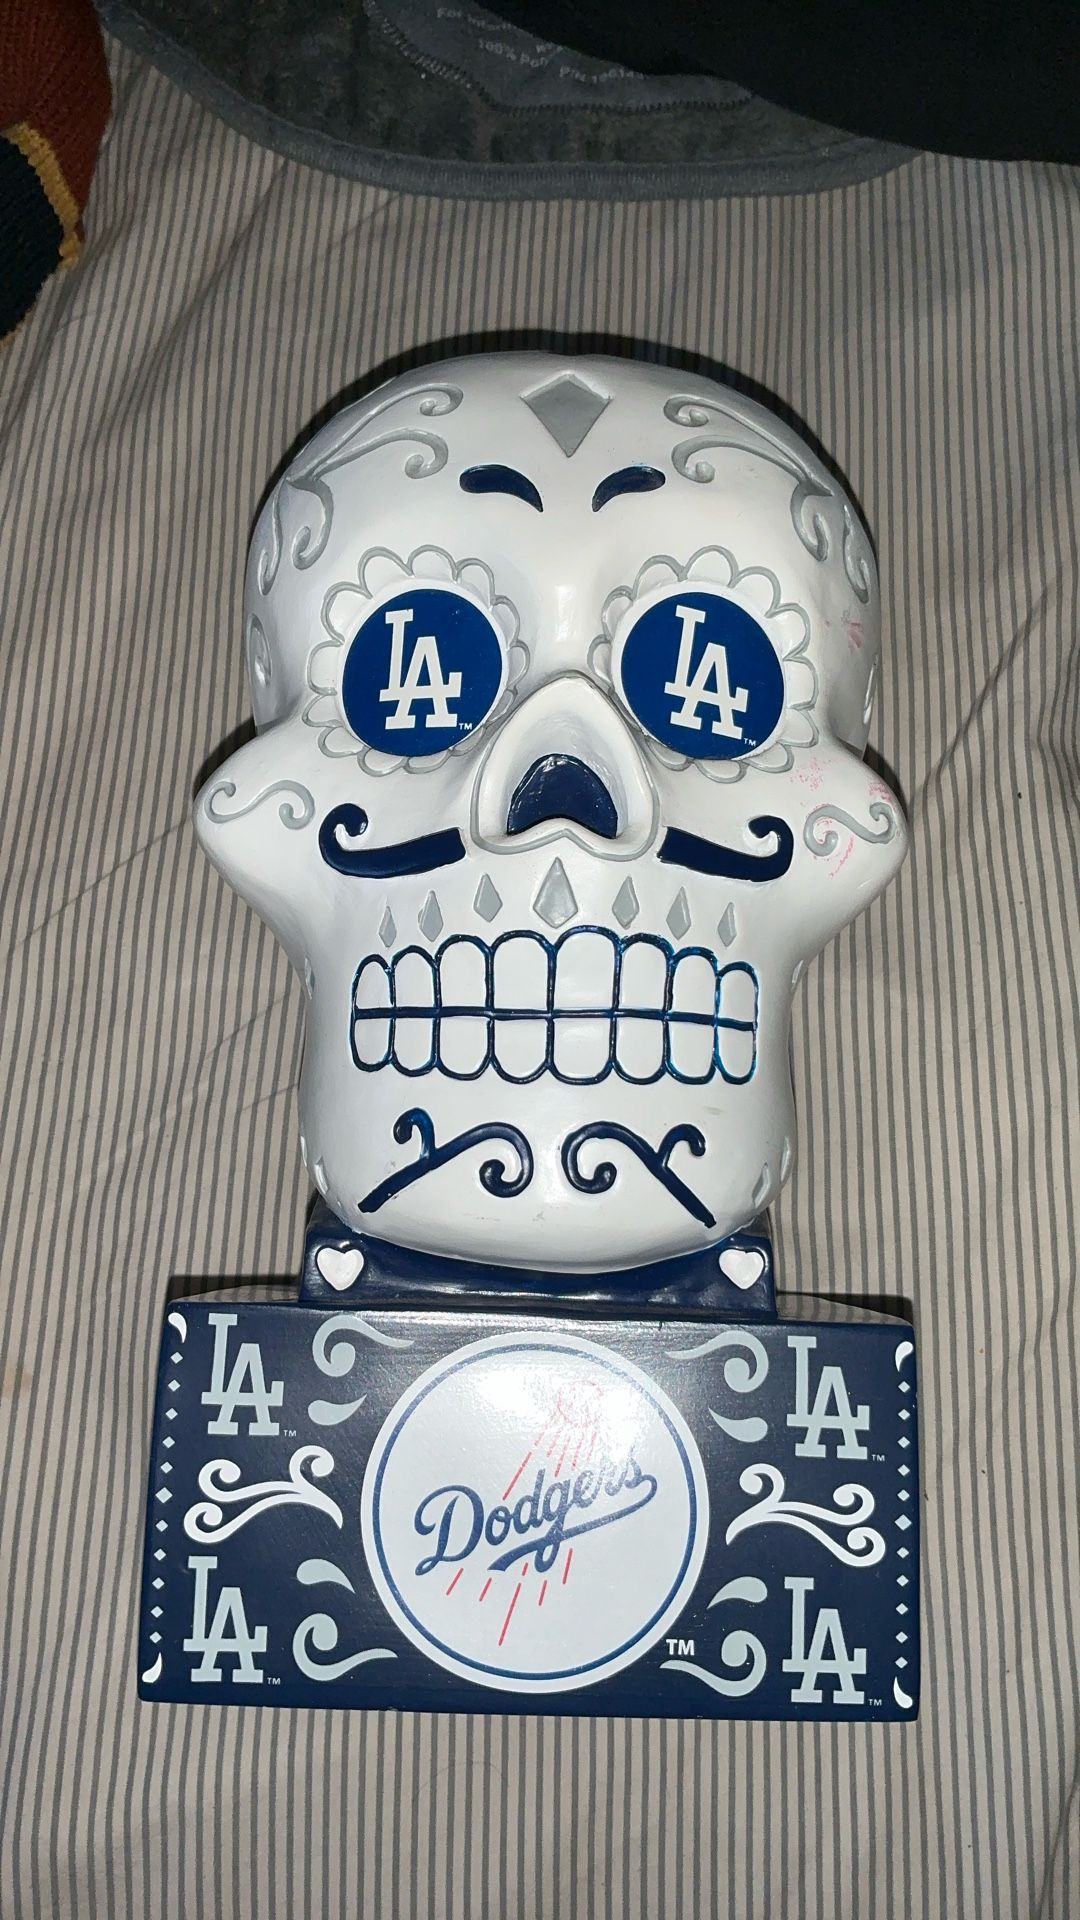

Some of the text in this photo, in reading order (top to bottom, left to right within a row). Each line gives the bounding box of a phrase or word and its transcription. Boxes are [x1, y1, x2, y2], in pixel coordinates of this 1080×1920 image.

[379, 608, 463, 730] LA
[664, 605, 749, 740] LA
[200, 1313, 285, 1436] LA
[787, 1335, 870, 1460] LA
[414, 1450, 658, 1576] Dodgers
[182, 1555, 268, 1684] LA
[666, 1639, 695, 1656] TM
[782, 1576, 867, 1705] LA
